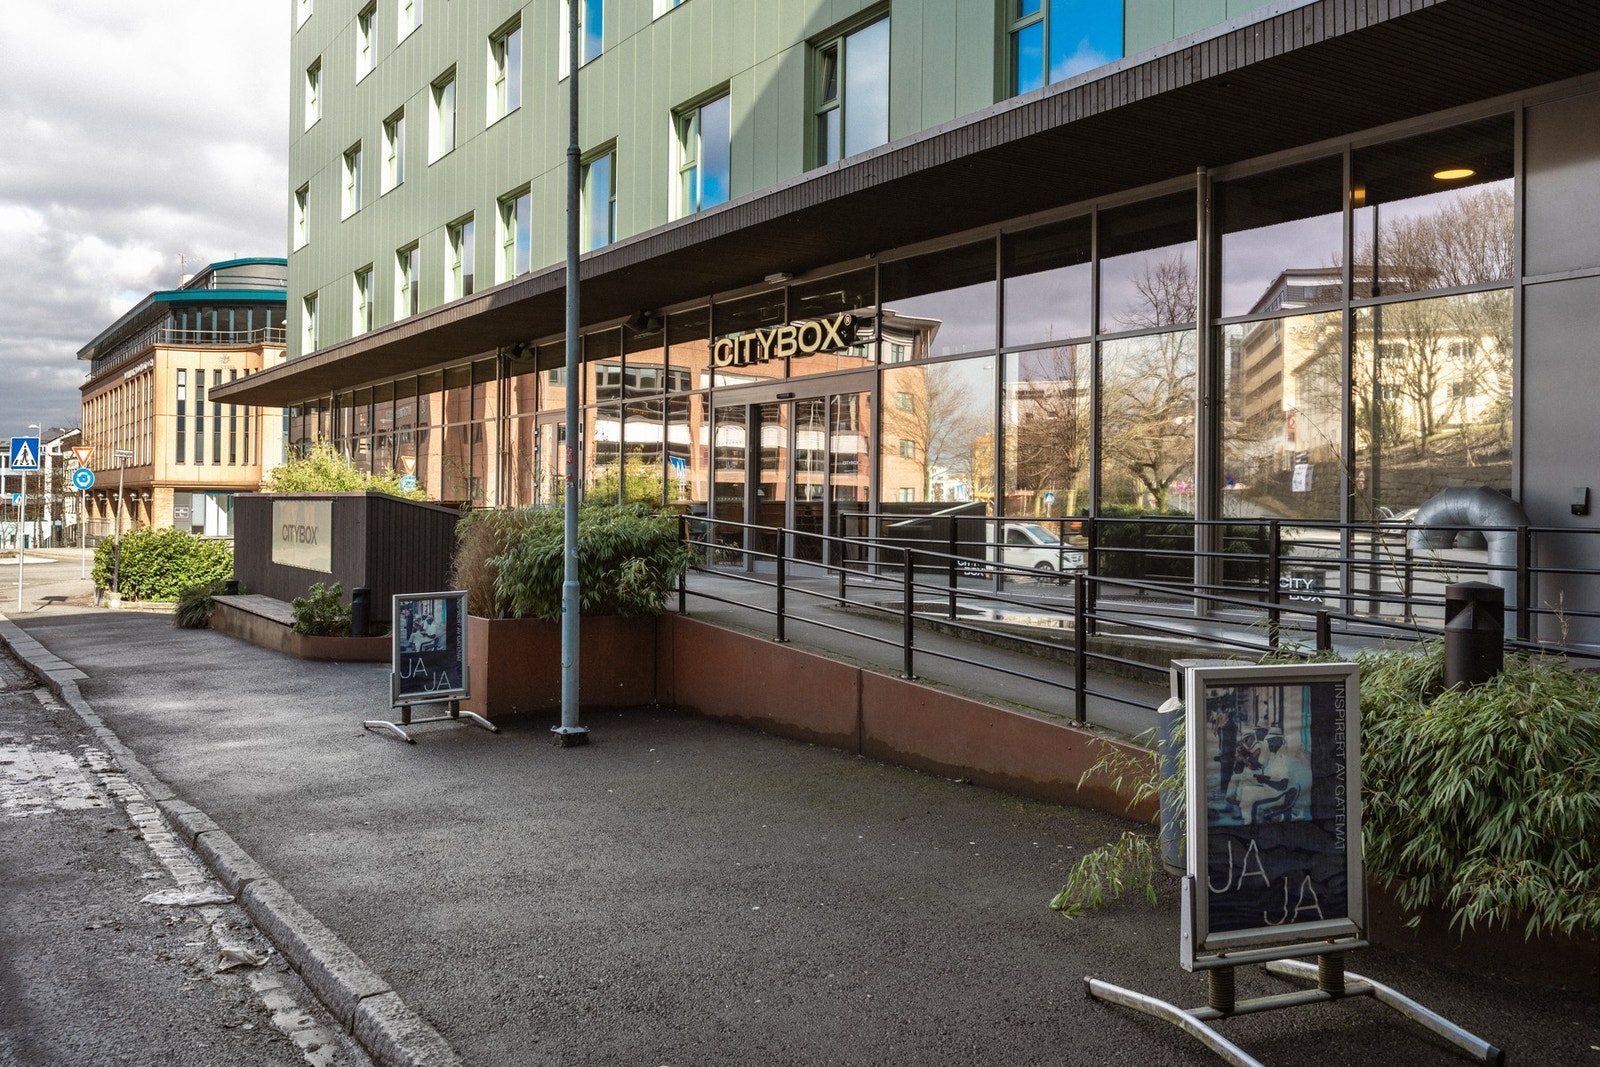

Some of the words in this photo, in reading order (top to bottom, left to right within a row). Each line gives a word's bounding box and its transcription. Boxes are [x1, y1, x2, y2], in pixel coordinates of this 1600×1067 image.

[1280, 577, 1313, 589] CITY
[400, 657, 428, 679] JA
[424, 670, 452, 692] JA
[1334, 683, 1346, 759] INSPIRERT
[1335, 762, 1346, 782] AV
[1334, 784, 1346, 852] GATEMAT
[1207, 839, 1271, 894] JA
[1263, 874, 1324, 926] JA
